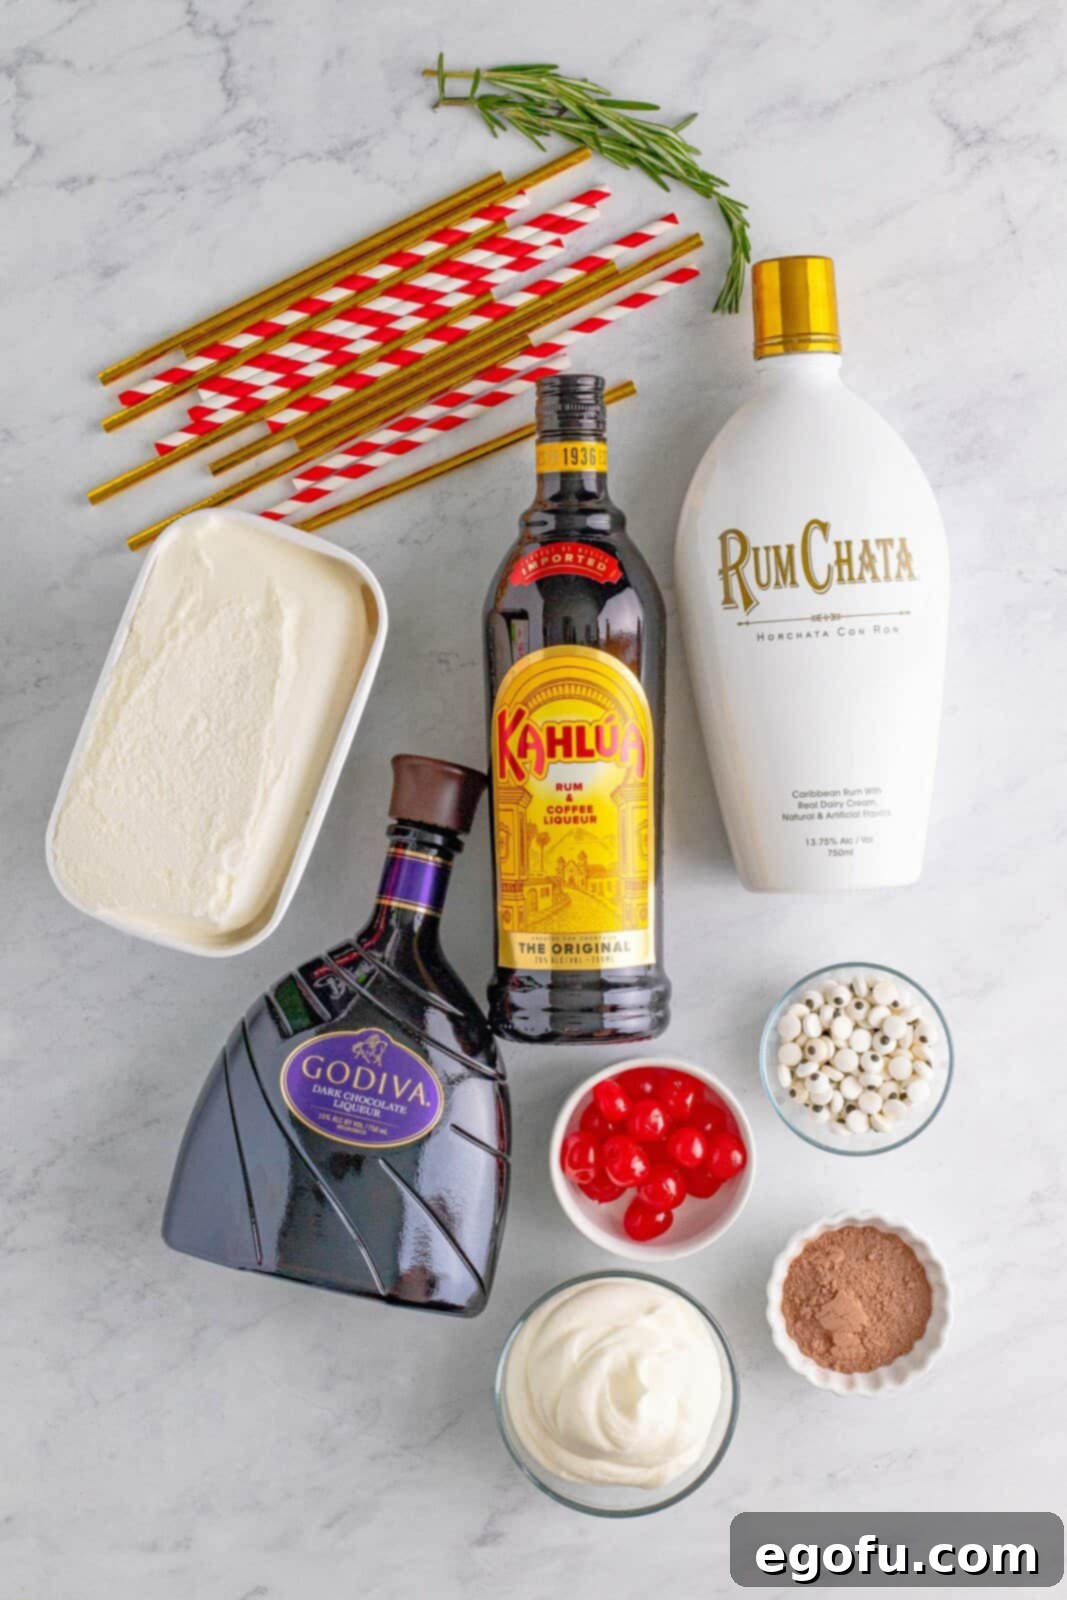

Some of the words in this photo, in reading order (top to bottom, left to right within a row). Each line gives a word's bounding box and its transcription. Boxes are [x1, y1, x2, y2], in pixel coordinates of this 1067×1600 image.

[563, 447, 596, 466] 1936
[521, 553, 607, 576] IMPORTED
[497, 707, 645, 781] KAHLÚA
[555, 782, 583, 792] RUM
[791, 789, 841, 799] Caribbean
[843, 787, 863, 797] Rum
[566, 793, 574, 803] &
[546, 804, 594, 815] COFFEE
[798, 800, 818, 809] Real
[820, 800, 844, 810] Dairy
[543, 815, 597, 825] LIQUEUR
[782, 812, 815, 822] Natural
[518, 942, 546, 955] THE
[551, 940, 632, 955] ORIGINAL
[312, 1084, 342, 1098] DARK
[343, 1091, 408, 1115] CHOCOLATE
[333, 1099, 382, 1118] LIQUEUR
